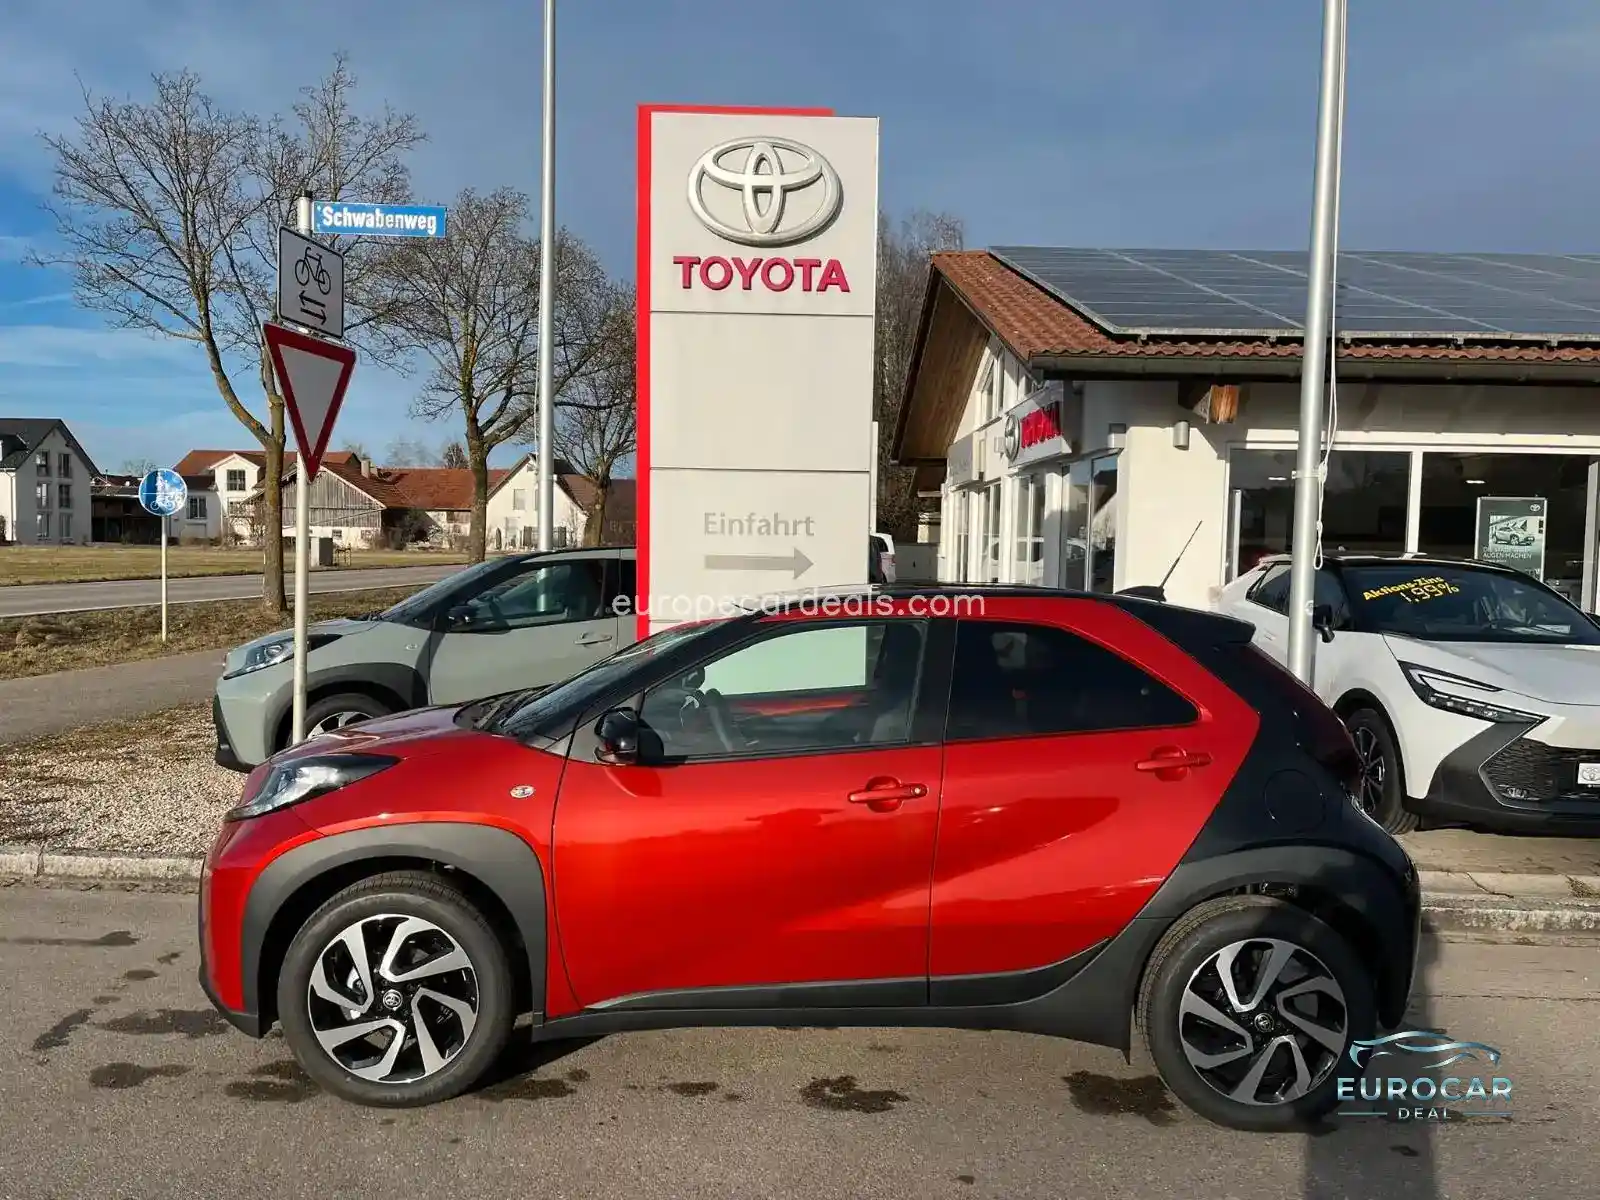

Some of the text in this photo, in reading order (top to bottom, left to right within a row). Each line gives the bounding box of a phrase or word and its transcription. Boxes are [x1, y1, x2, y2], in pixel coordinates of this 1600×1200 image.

[322, 206, 437, 235] Schwabenweg
[673, 256, 850, 293] TOYOTA
[704, 512, 815, 536] Einfahrt
